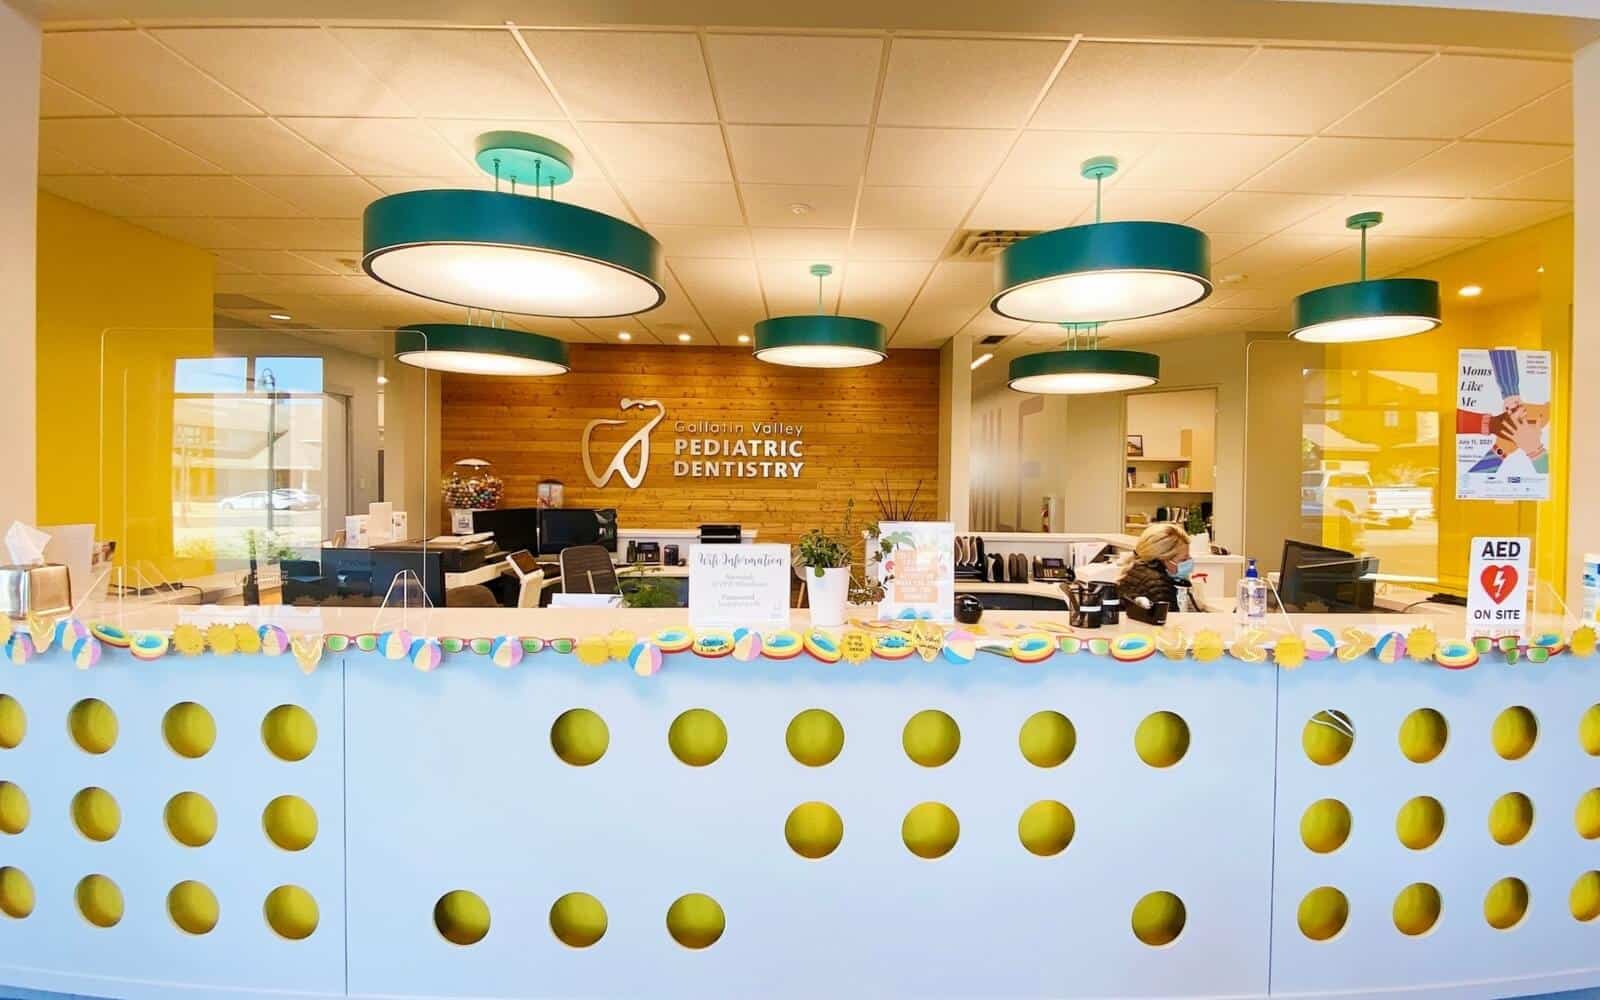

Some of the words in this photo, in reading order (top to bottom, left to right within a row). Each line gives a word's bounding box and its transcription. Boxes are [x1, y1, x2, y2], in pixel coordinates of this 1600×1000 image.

[1462, 366, 1492, 376] Moms
[1460, 380, 1484, 392] Like
[1461, 396, 1477, 407] Me
[674, 420, 745, 433] Gallatin
[752, 422, 803, 437] Valley
[674, 439, 803, 457] PEDIATRIC
[673, 460, 805, 477] DENTISTRY
[1481, 541, 1521, 557] AED
[720, 551, 783, 569] Information
[1473, 609, 1491, 619] ON
[1495, 609, 1521, 619] SITE
